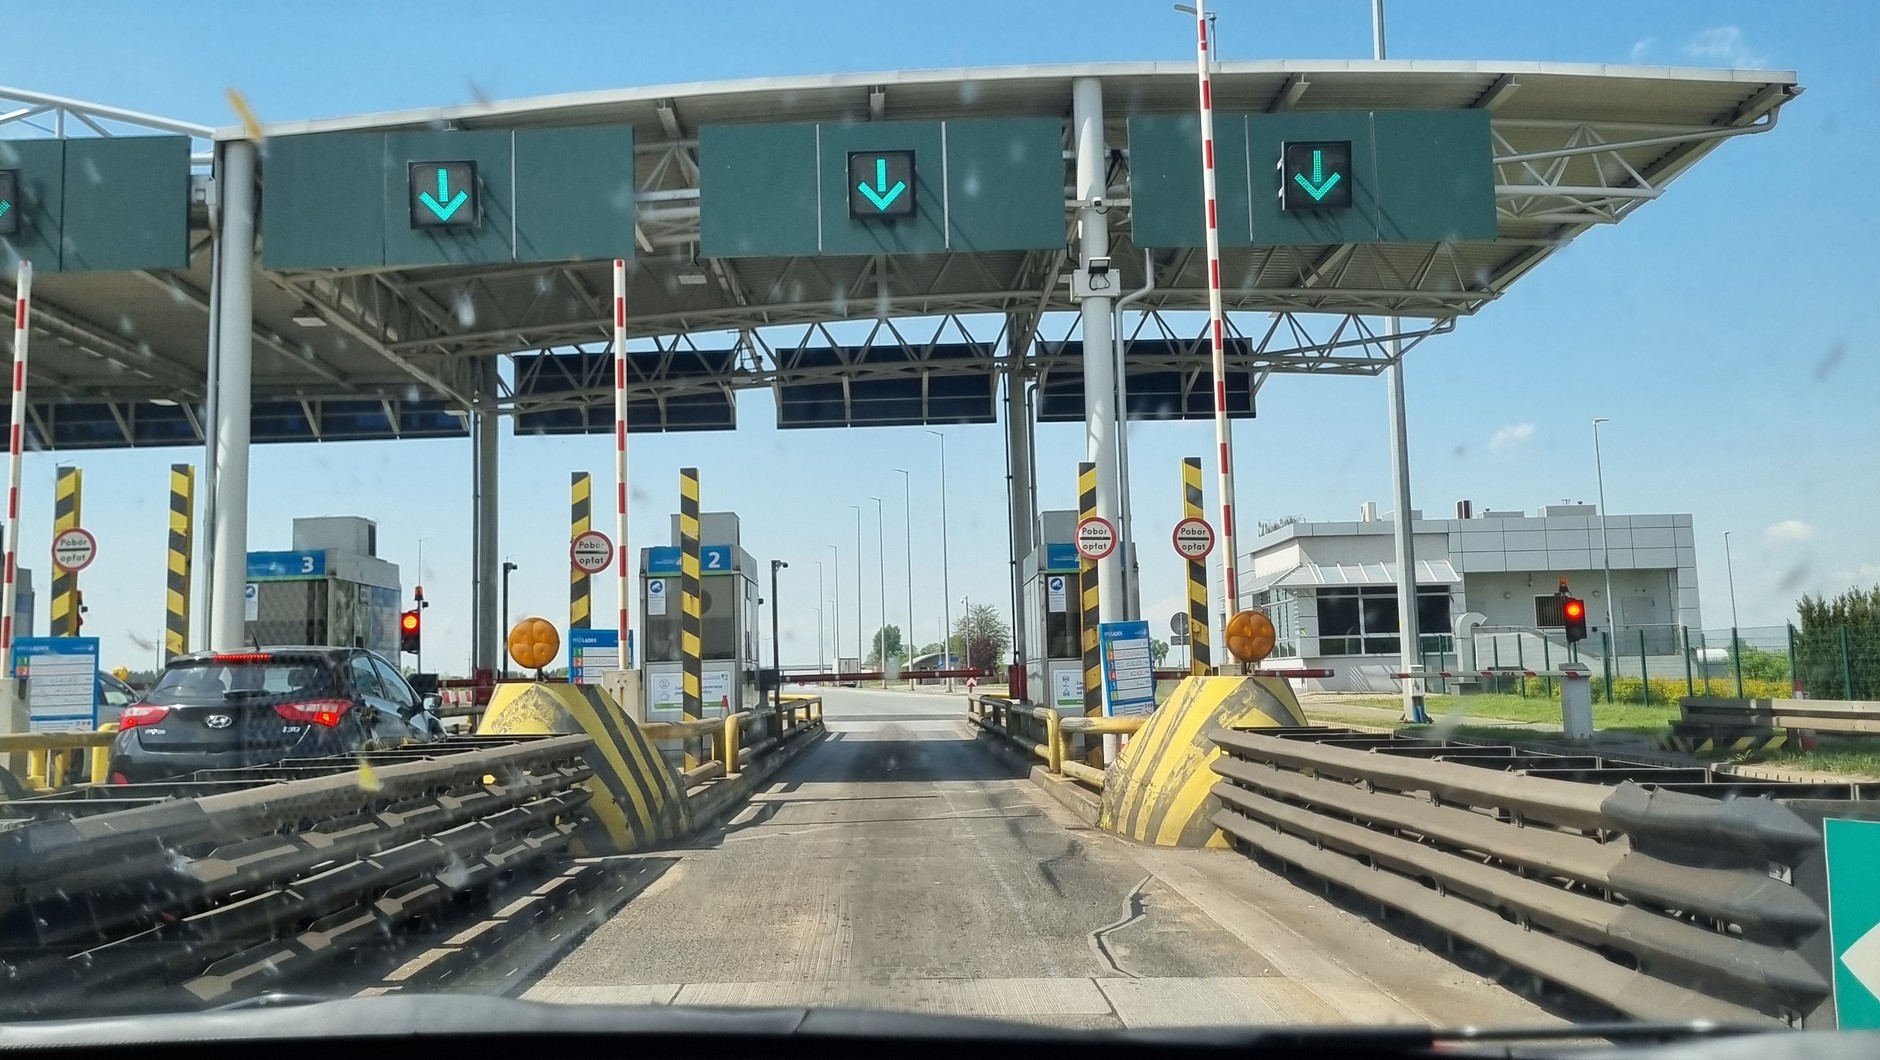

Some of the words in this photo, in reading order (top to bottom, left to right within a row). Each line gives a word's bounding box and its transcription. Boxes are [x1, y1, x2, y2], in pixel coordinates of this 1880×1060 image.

[1082, 526, 1107, 535] Pobór
[1181, 527, 1206, 535] Pobór
[1083, 543, 1107, 551] opłat
[1182, 543, 1206, 551] opłat
[579, 556, 603, 565] opłat
[708, 551, 721, 568] 2
[302, 556, 314, 573] 3
[577, 668, 582, 676] 3
